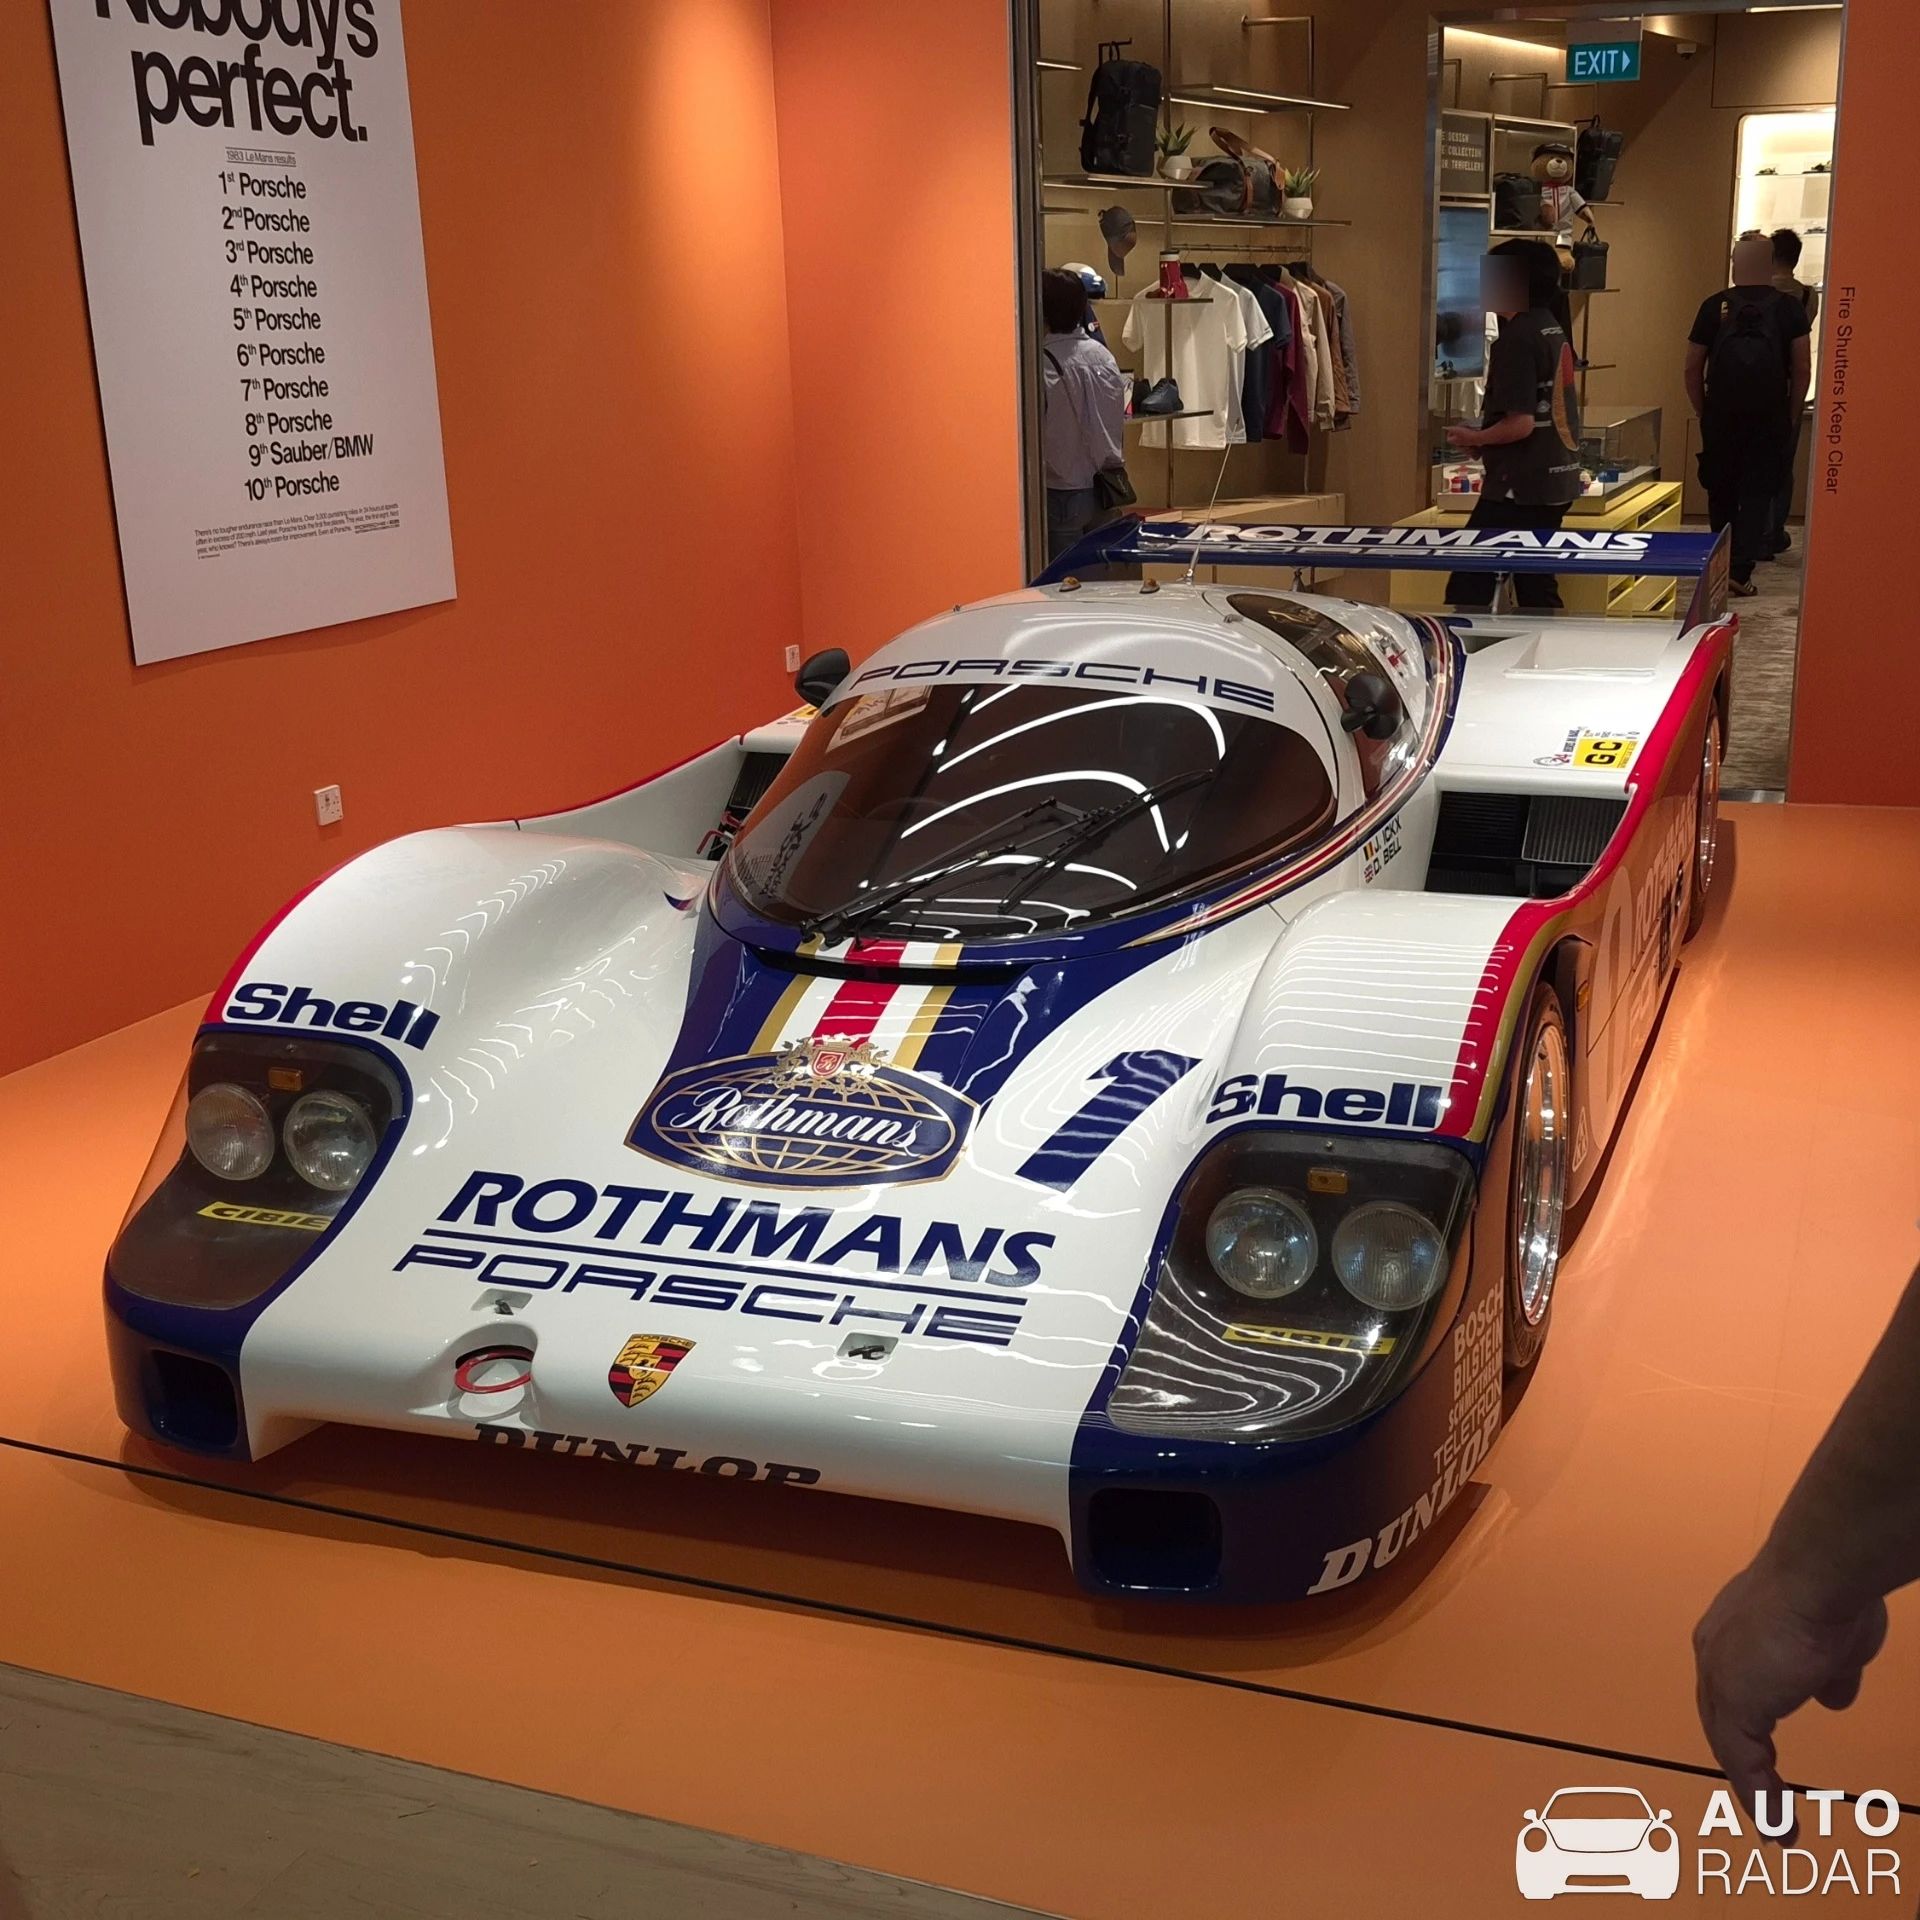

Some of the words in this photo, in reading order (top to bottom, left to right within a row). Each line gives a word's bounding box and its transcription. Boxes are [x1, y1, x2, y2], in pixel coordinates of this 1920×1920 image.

[1575, 50, 1619, 75] EXIT
[131, 44, 368, 145] perfect.
[226, 150, 244, 161] 1983
[246, 151, 254, 161] Le
[254, 152, 273, 163] Mans
[274, 155, 297, 165] results
[219, 171, 235, 194] 1st
[239, 172, 306, 199] Porsche
[222, 206, 242, 229] 2nd
[243, 206, 310, 232] Porsche
[225, 240, 244, 263] 3rd
[247, 240, 314, 265] Porsche
[230, 274, 248, 297] 4th
[251, 274, 318, 298] Porsche
[1838, 286, 1856, 319] Fire
[233, 308, 252, 330] 5th
[255, 307, 321, 331] Porsche
[237, 343, 257, 366] 6th
[259, 342, 325, 366] Porsche
[1832, 324, 1853, 396] Shutters
[240, 378, 261, 401] 7th
[263, 375, 329, 400] Porsche
[245, 412, 265, 436] 8th
[267, 409, 333, 434] Porsche
[1826, 401, 1847, 445] Keep
[248, 443, 268, 467] 9th
[270, 434, 374, 465] Sauber/BMW
[244, 477, 272, 501] 10th
[275, 471, 340, 498] Porsche
[1826, 450, 1844, 495] Clear
[1184, 525, 1653, 550] ROTHMANS
[850, 659, 1274, 712] PORSCHE
[1374, 836, 1382, 853] J.
[1382, 814, 1402, 845] ICKX
[1373, 857, 1382, 876] D.
[1383, 837, 1402, 865] BELL
[226, 983, 441, 1051] Shell
[1206, 1074, 1444, 1129] Shell
[669, 1086, 923, 1157] Rothmans
[1015, 1049, 1204, 1194] 1
[211, 1207, 332, 1229] CIBIE
[437, 1170, 1056, 1289] ROTHMANS
[392, 1243, 1026, 1347] PORSCHE
[1454, 1277, 1504, 1364] BOSCH
[1454, 1317, 1503, 1400] BILSTEIN
[1434, 1381, 1501, 1475] TELETRON
[1306, 1404, 1500, 1596] DUNLOP
